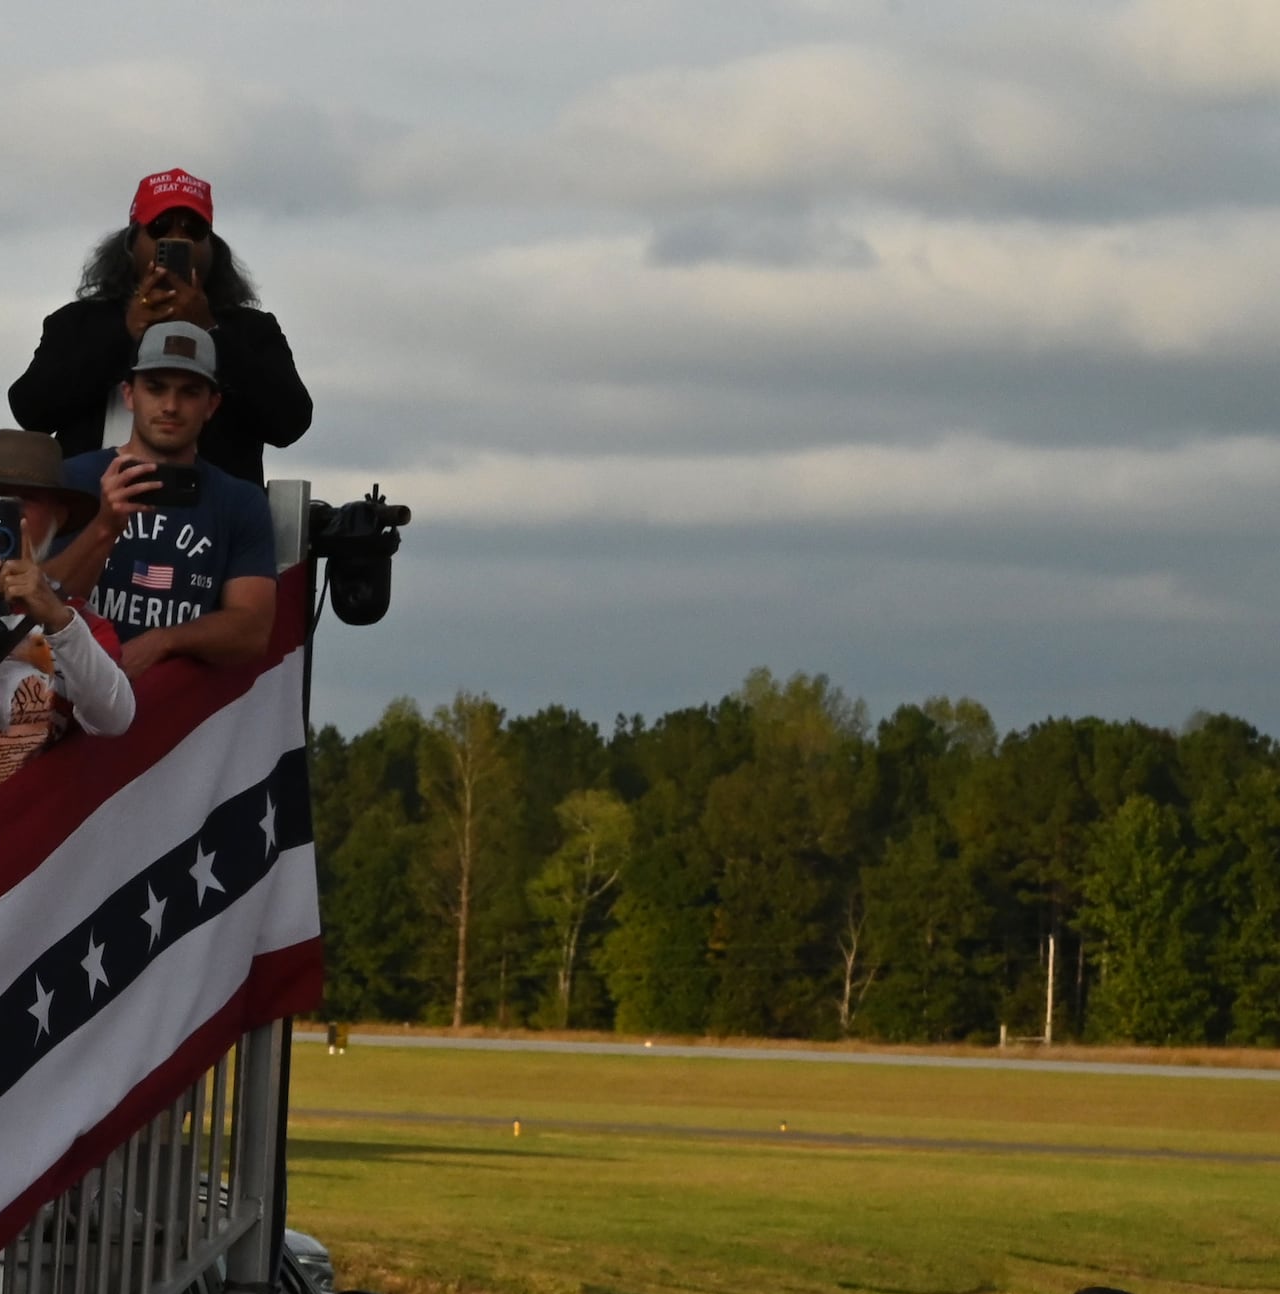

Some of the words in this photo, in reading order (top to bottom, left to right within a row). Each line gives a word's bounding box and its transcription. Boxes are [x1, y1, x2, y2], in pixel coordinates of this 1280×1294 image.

[149, 174, 172, 186] MAKE
[154, 183, 180, 195] GREAT
[114, 511, 167, 545] ULF
[175, 523, 212, 559] OF
[190, 573, 213, 589] 2025
[89, 584, 201, 628] AMERICA
